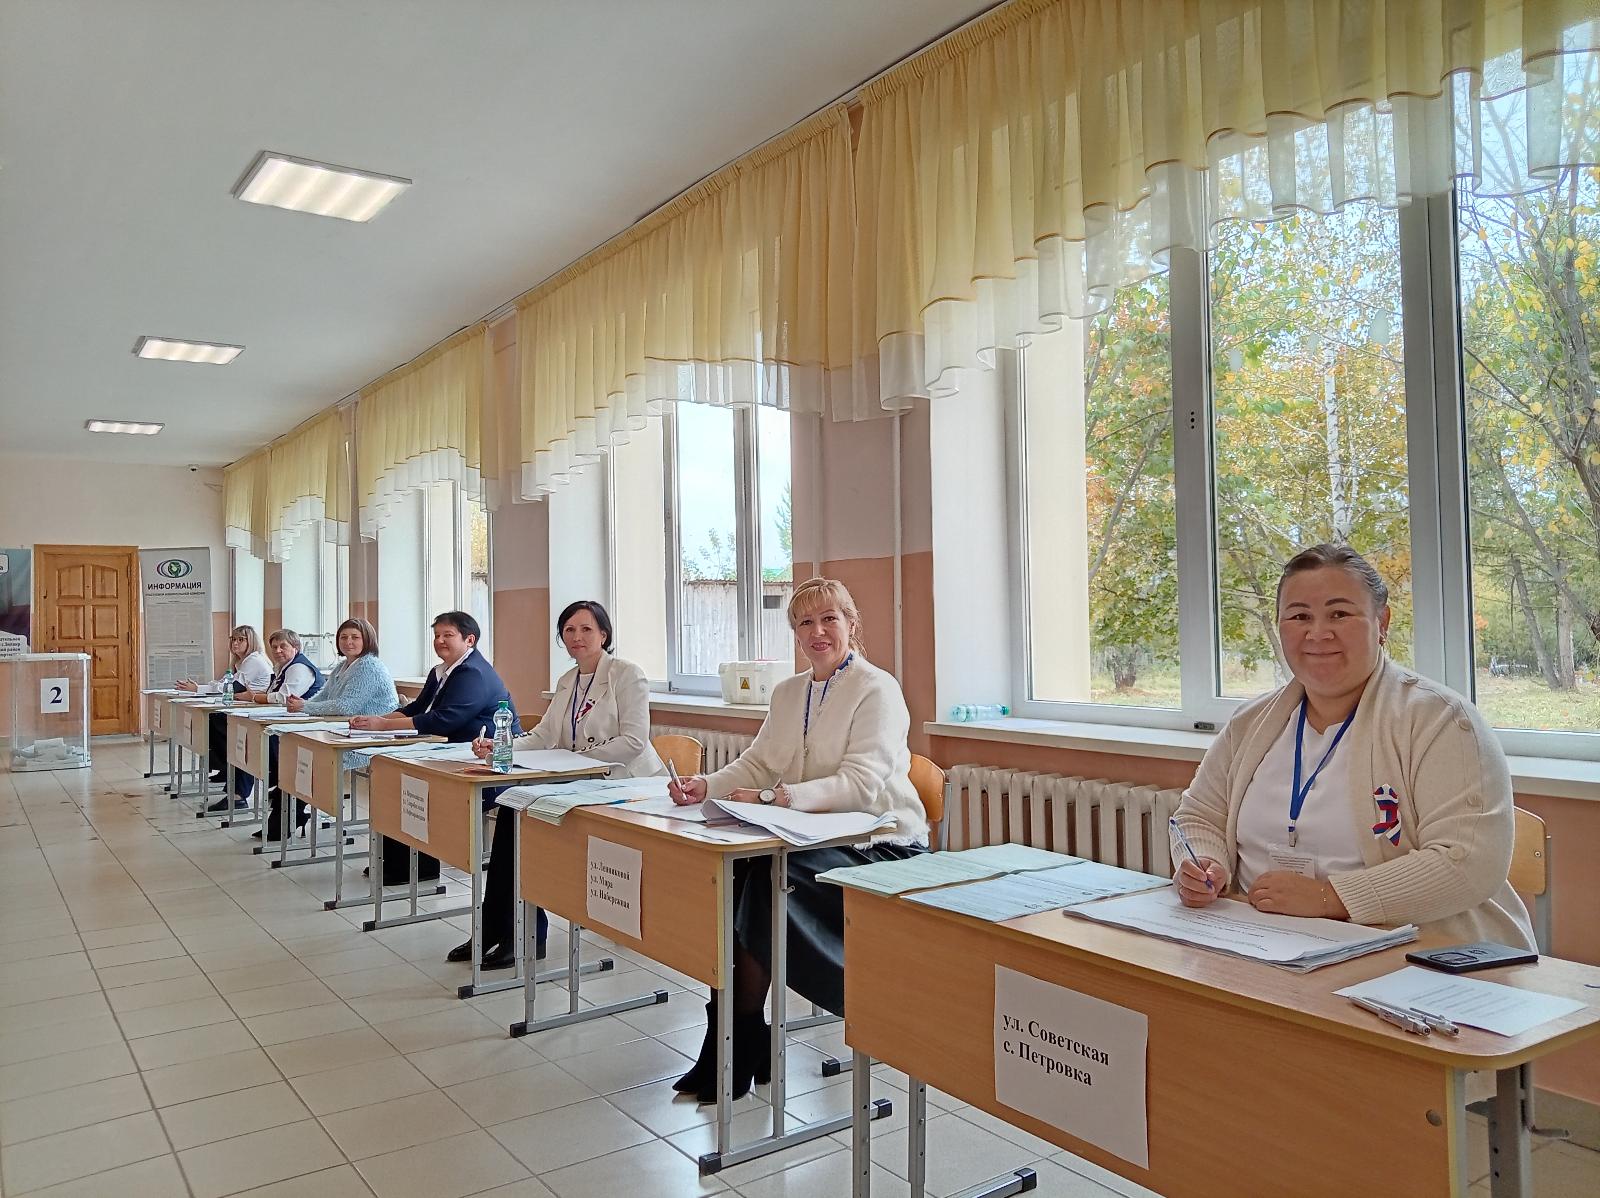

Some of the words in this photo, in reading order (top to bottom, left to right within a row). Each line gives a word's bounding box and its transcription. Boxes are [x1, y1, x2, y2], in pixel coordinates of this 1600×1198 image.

[147, 581, 202, 590] ИНФОРМАЦИЯ
[49, 686, 63, 704] 2
[599, 875, 613, 889] Мира
[599, 889, 630, 909] Набережная
[1003, 1014, 1024, 1033] ул.
[1028, 1020, 1109, 1066] Советская
[1003, 1040, 1015, 1055] с.
[1018, 1041, 1092, 1086] Петровка
